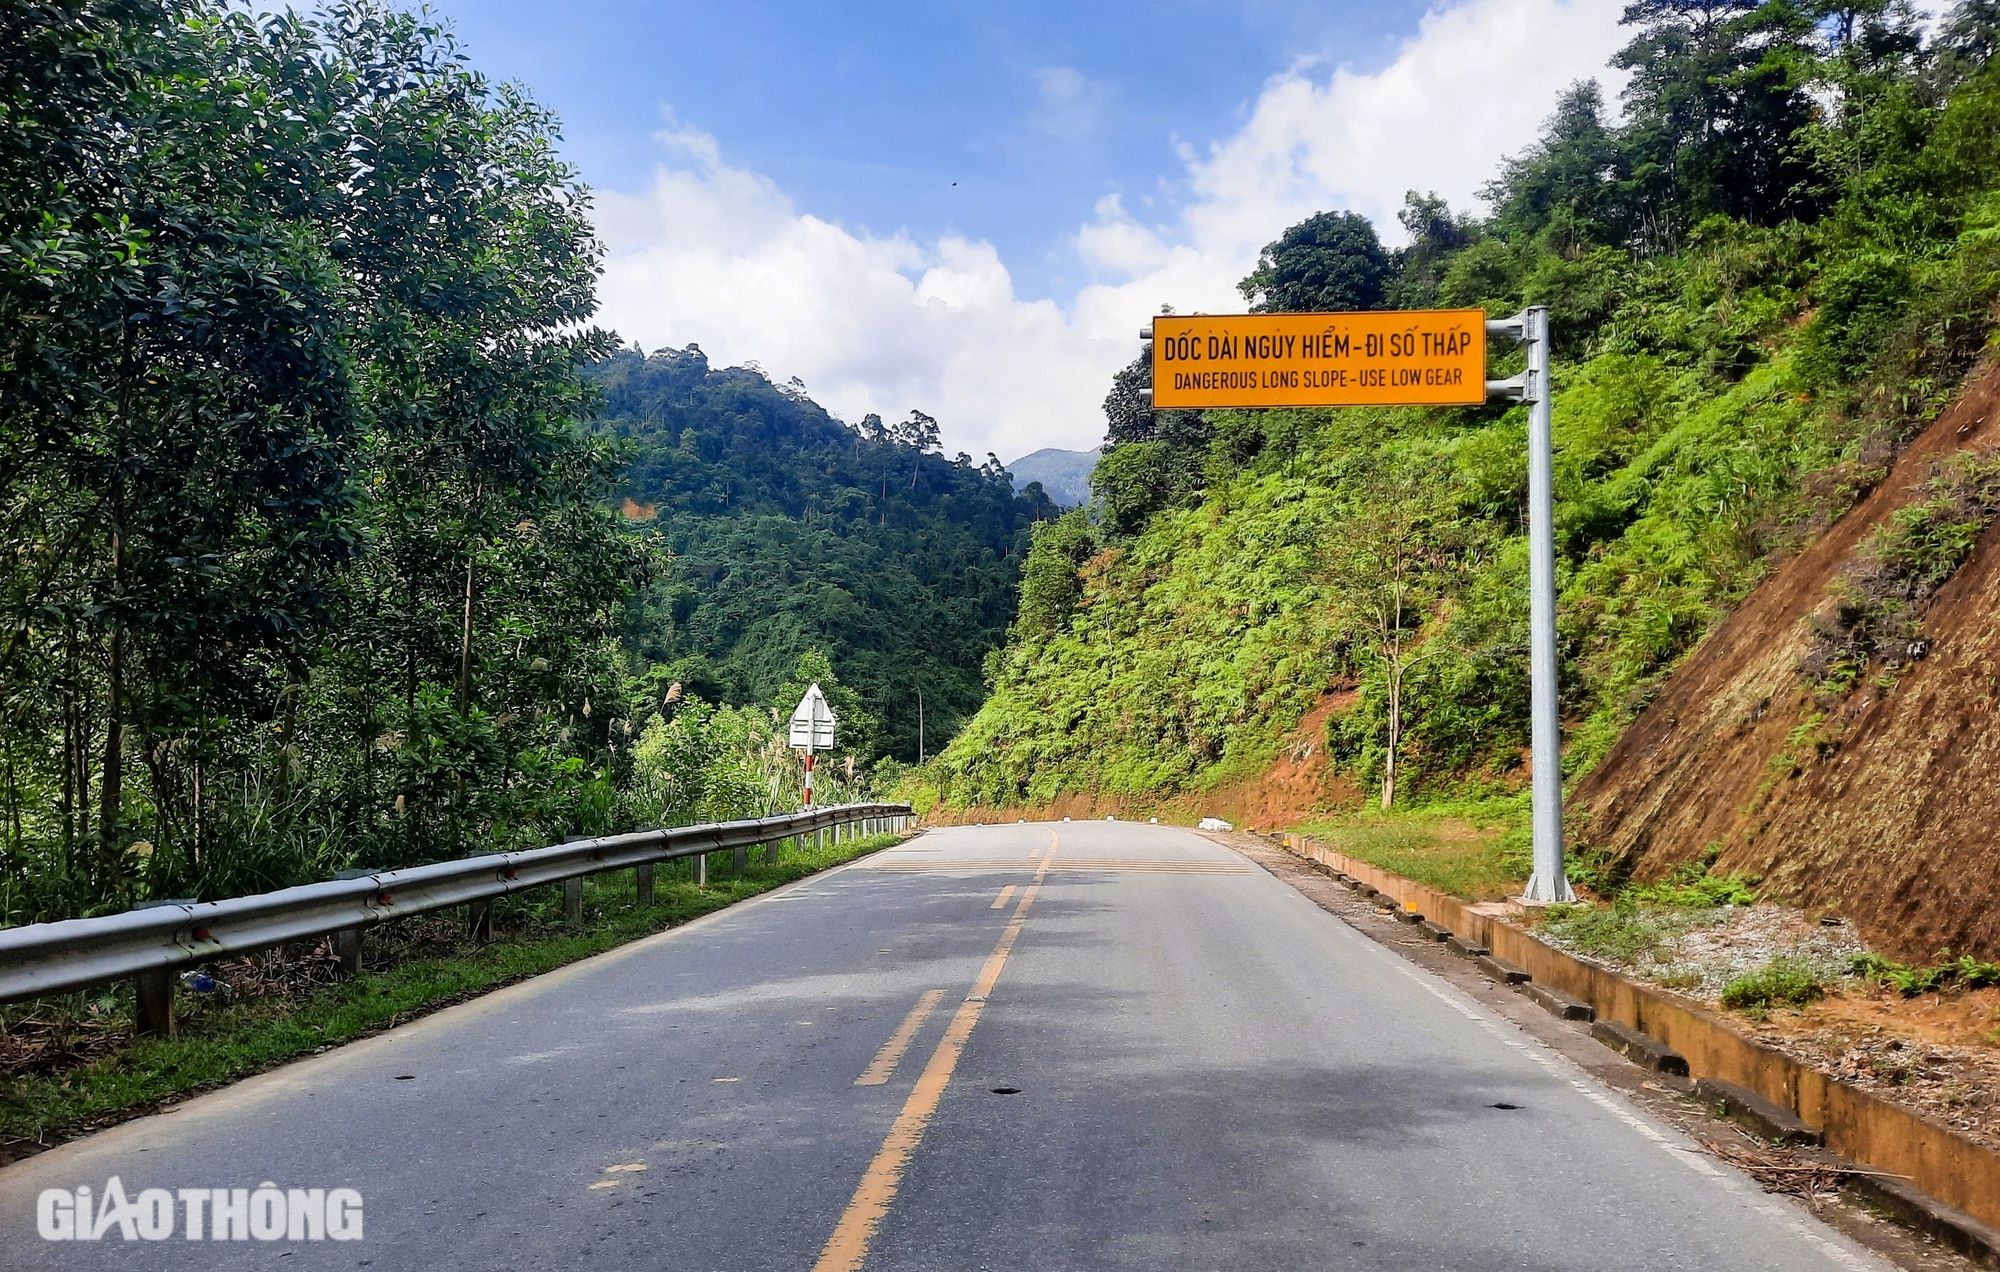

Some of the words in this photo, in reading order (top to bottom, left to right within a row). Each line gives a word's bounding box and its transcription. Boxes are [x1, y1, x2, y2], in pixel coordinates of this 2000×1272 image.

[1165, 328, 1202, 361] DỐC
[1208, 330, 1238, 360] DÀI
[1390, 325, 1419, 357] SỐ
[1421, 324, 1471, 356] THẤP
[1174, 371, 1257, 390] DANGEROUS
[1262, 371, 1299, 389] LONG
[1391, 368, 1422, 387] LOW
[1426, 368, 1463, 386] GEAR
